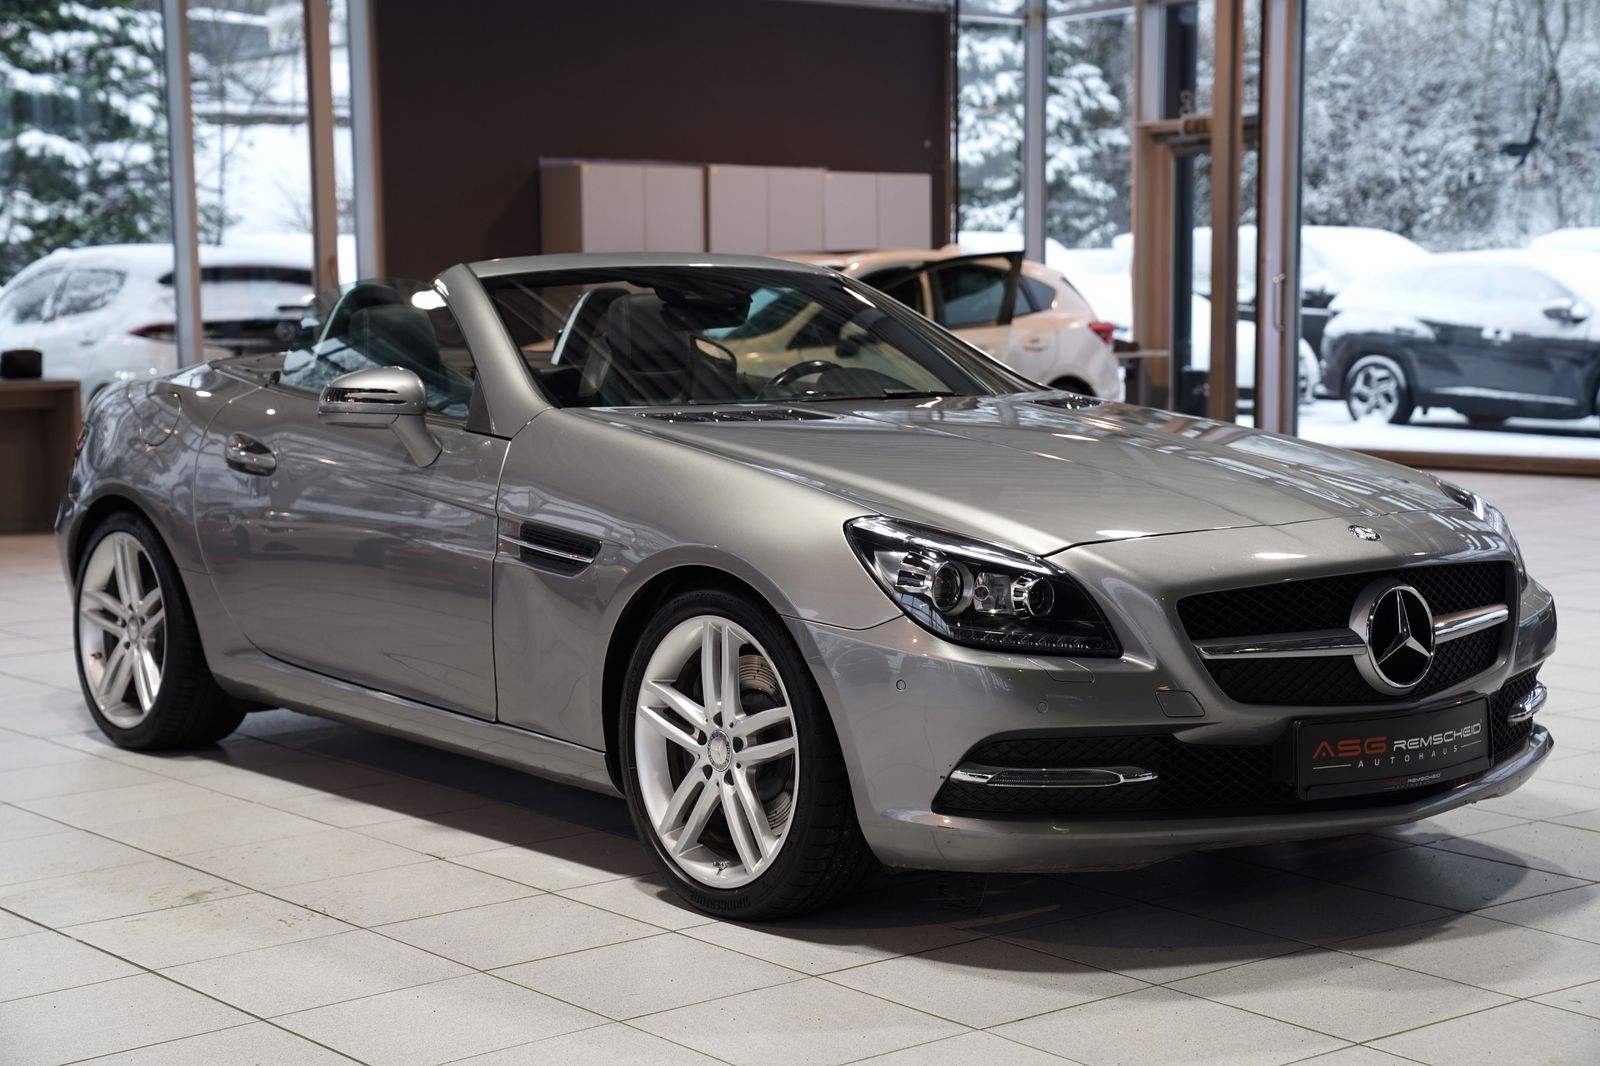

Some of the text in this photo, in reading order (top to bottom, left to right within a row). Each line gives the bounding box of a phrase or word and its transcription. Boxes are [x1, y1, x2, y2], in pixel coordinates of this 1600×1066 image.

[1312, 723, 1482, 759] ASG REMSCHEID
[1357, 745, 1458, 768] AUTOHAUS
